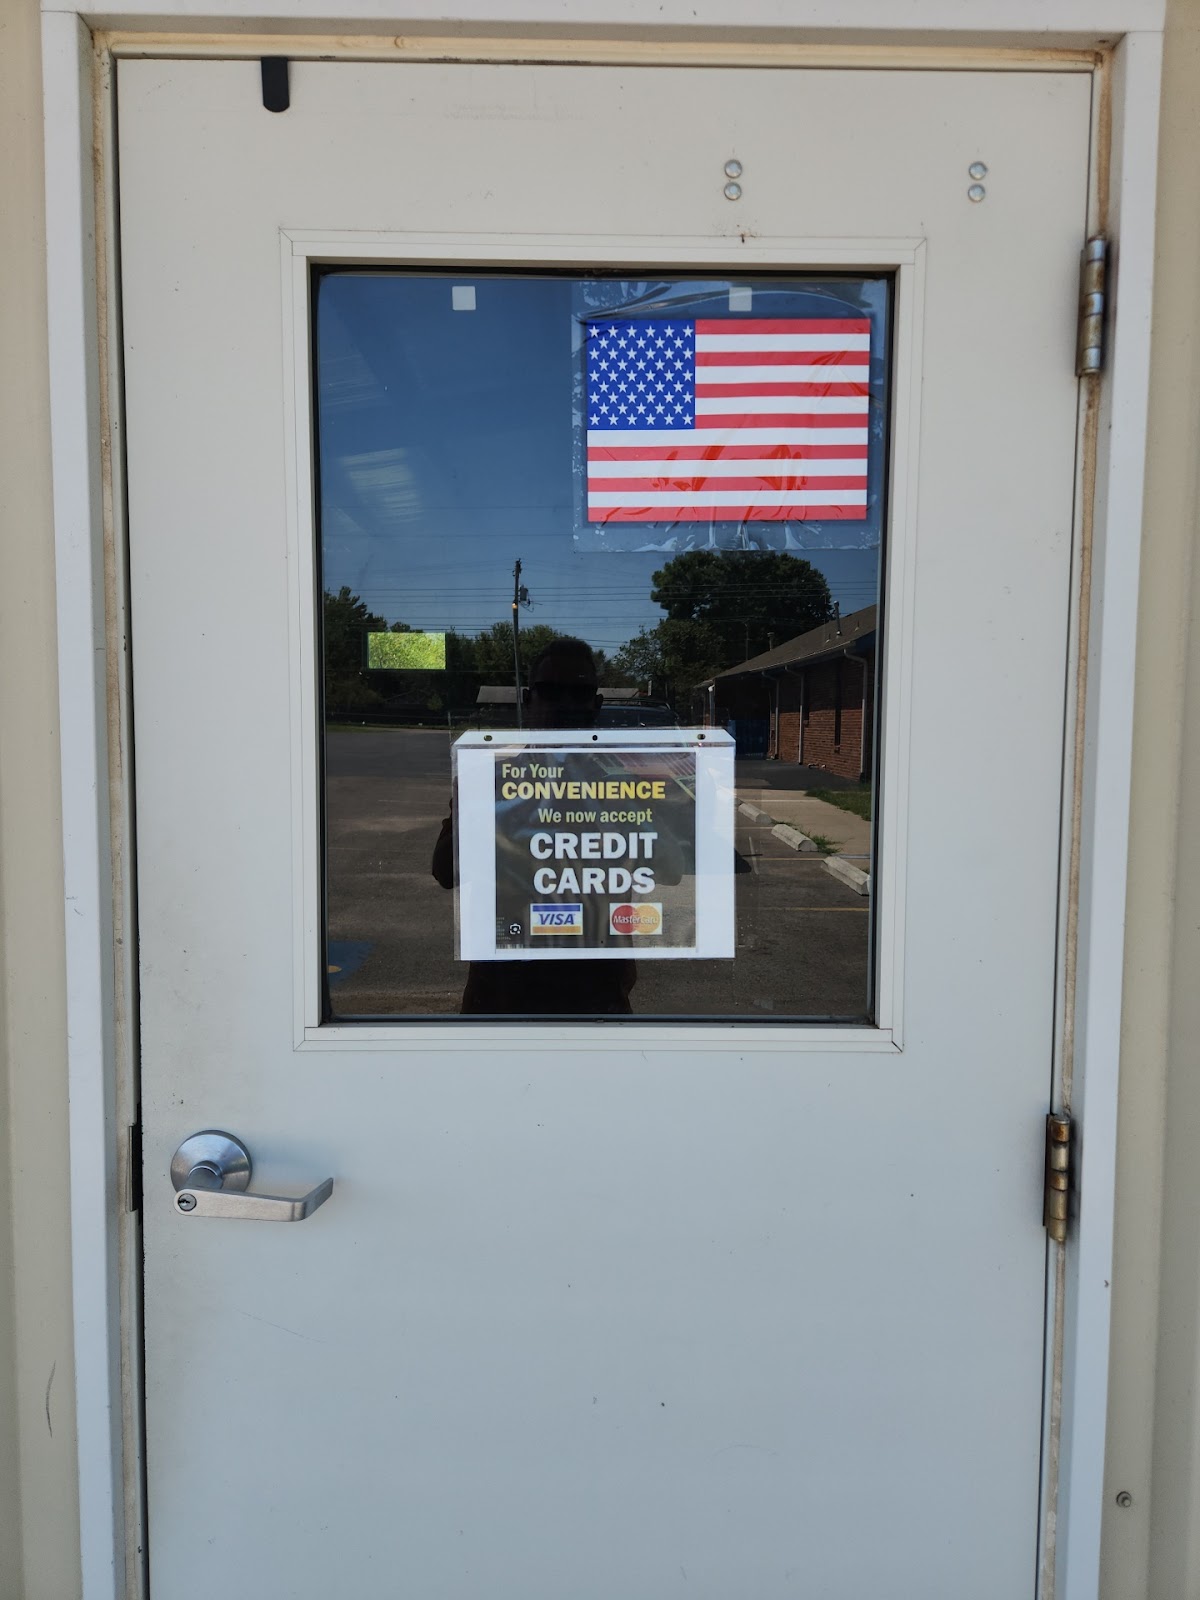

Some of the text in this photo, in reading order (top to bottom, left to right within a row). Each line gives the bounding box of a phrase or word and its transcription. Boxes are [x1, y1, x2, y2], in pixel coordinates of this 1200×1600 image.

[502, 763, 564, 779] For Your
[502, 781, 666, 800] CONVENIENCE
[538, 808, 653, 826] We now accept
[529, 832, 658, 860] CREDIT
[533, 867, 656, 895] CARDS
[538, 913, 575, 925] VISA
